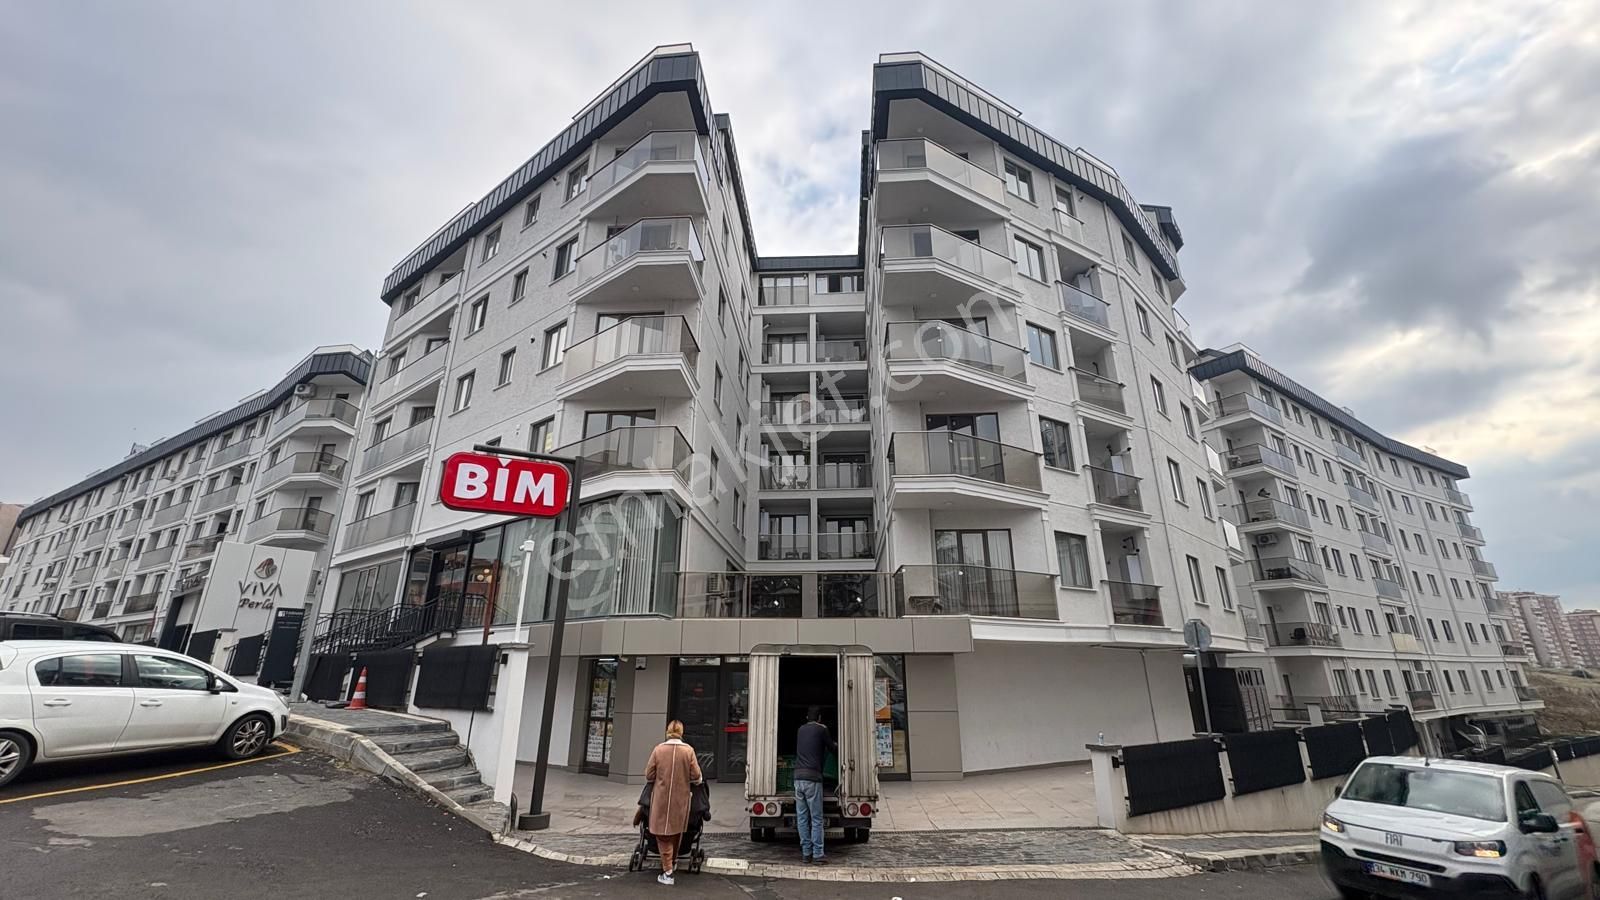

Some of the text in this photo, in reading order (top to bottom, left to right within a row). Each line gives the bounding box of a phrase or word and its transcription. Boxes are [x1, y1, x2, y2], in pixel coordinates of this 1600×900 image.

[453, 458, 555, 507] BİM
[240, 598, 274, 609] Perla
[1385, 832, 1403, 847] FIAT
[1389, 867, 1407, 879] NKM
